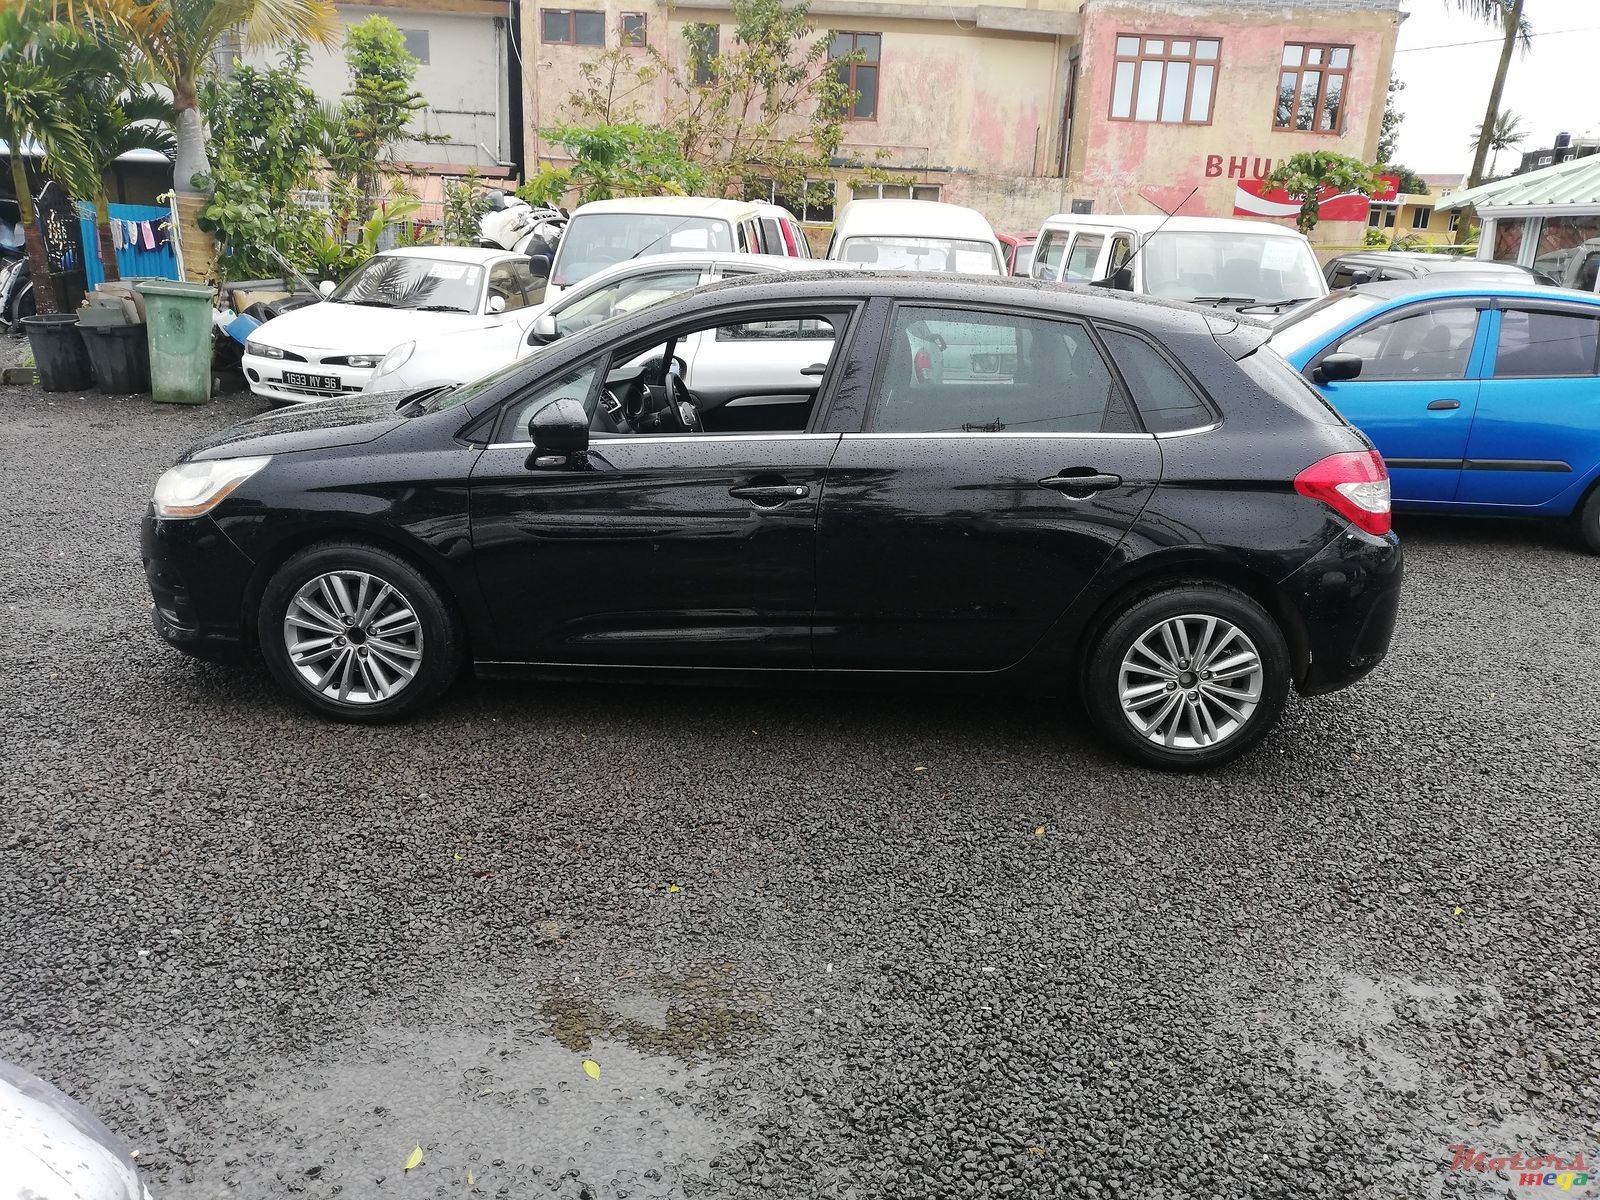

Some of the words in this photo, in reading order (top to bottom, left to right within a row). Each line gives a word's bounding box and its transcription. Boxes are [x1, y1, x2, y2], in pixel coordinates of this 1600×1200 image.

[1205, 154, 1285, 180] BHU
[286, 373, 306, 386] 1633
[309, 375, 320, 387] MY
[324, 378, 336, 389] 96
